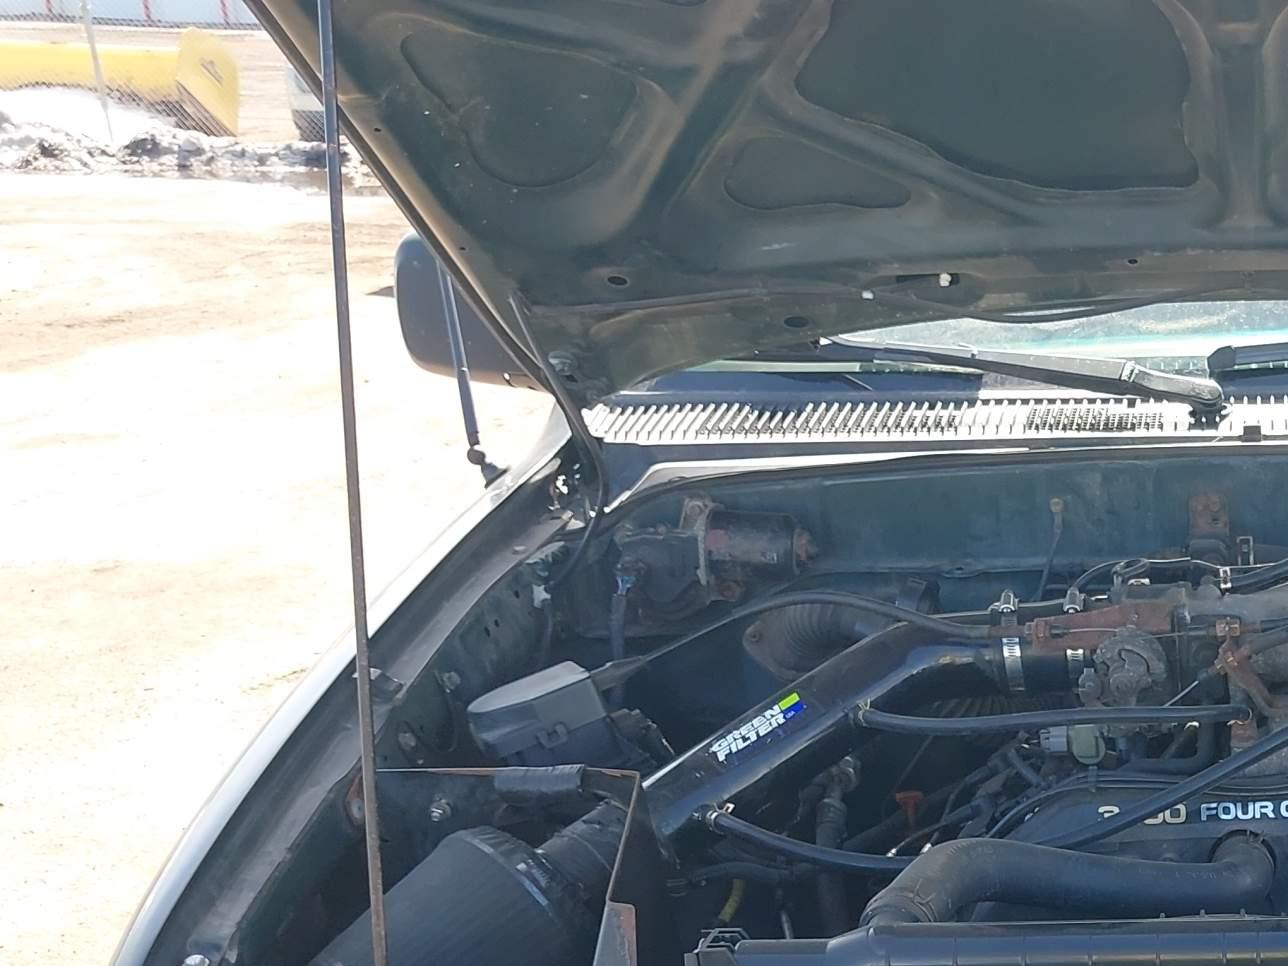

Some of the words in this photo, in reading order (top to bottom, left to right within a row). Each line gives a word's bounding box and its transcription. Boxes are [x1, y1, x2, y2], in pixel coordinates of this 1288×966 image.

[709, 704, 782, 753] GREEN
[716, 712, 787, 762] FILTER
[1200, 800, 1275, 821] FOUR
